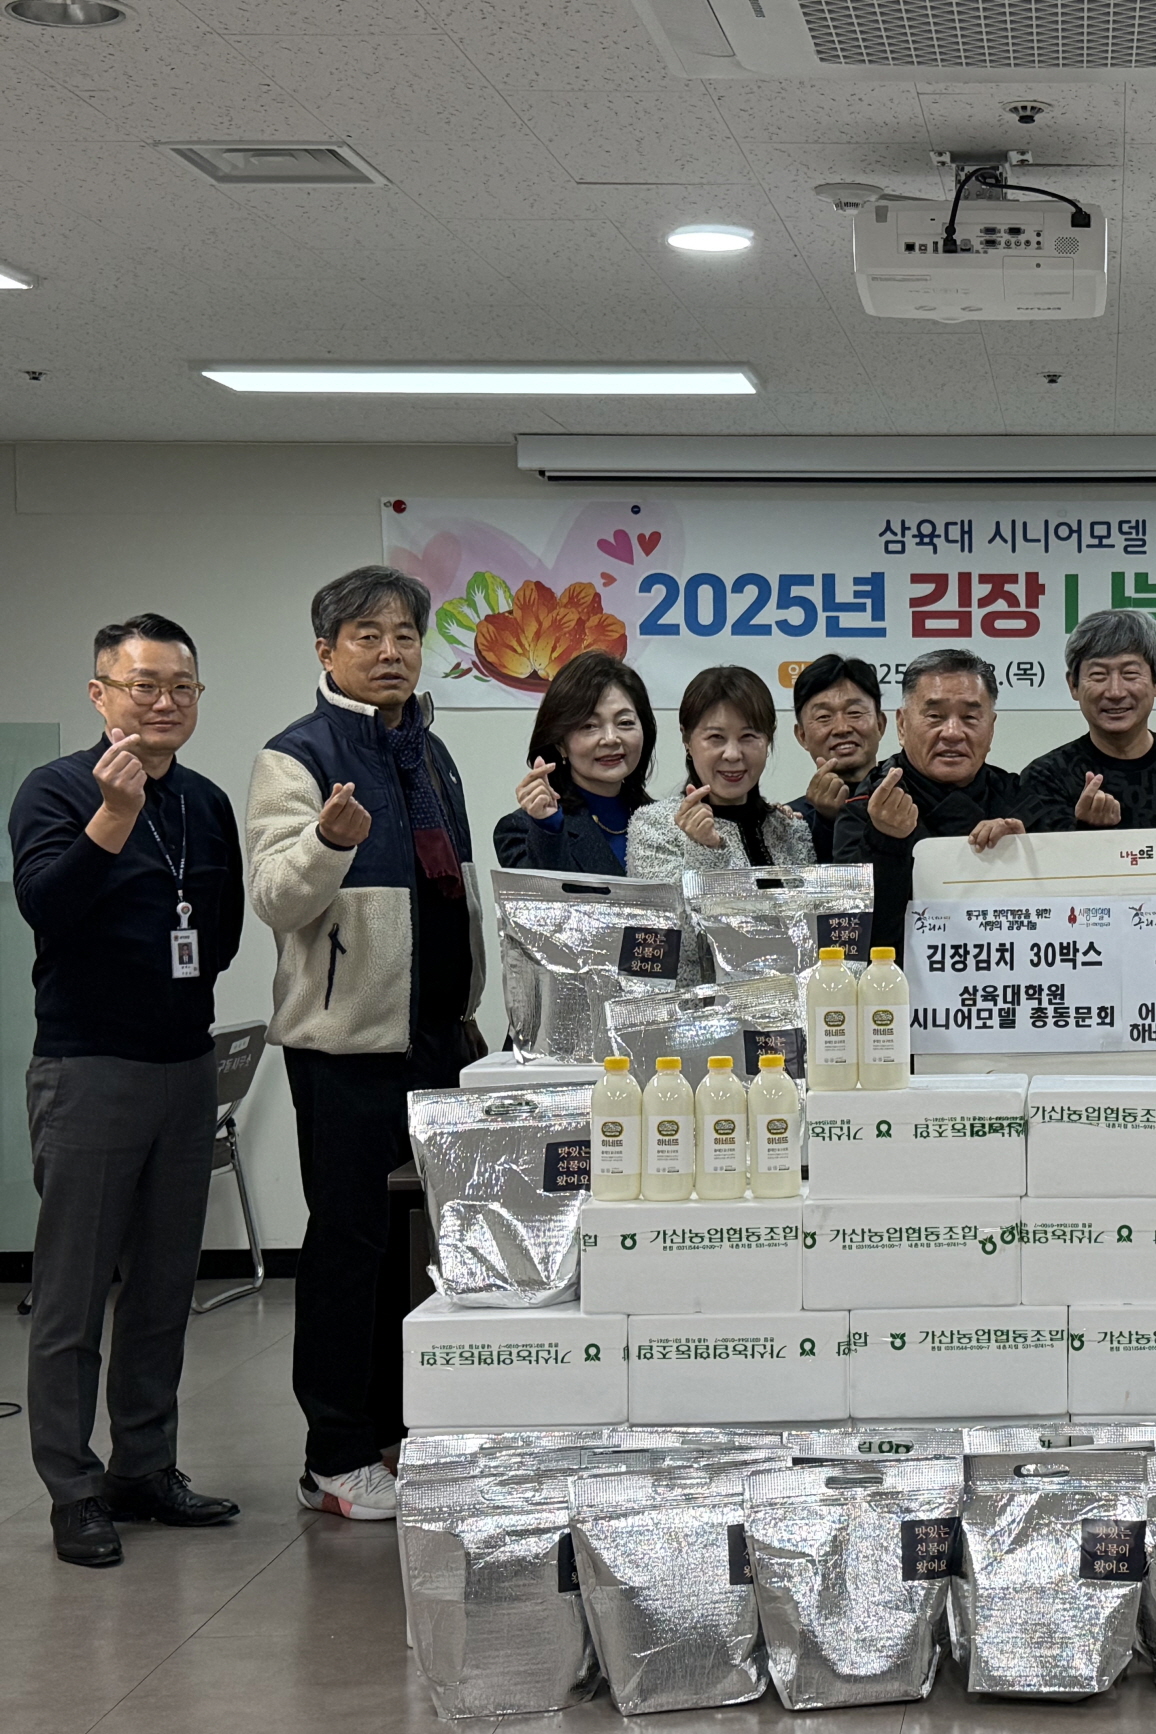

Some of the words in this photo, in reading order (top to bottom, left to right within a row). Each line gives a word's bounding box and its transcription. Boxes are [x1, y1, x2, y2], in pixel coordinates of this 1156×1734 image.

[878, 519, 973, 555] 삼육대
[987, 518, 1148, 555] 시니어모델
[637, 571, 887, 638] 2025년
[908, 571, 1046, 638] 김장
[1119, 845, 1154, 866] 나눔으로
[829, 917, 860, 928] 맛있는
[635, 932, 666, 945] 맛있는
[633, 946, 664, 960] 선물이
[926, 941, 1015, 972] 김장김치
[1029, 940, 1103, 970] 30박스
[631, 960, 662, 972] 왔어요
[959, 983, 1066, 1007] 삼육대학원
[910, 1007, 1017, 1030] 시니어모델
[1029, 1005, 1115, 1029] 총동문회
[601, 1139, 623, 1147] 하네뜨
[657, 1138, 680, 1147] 하네뜨
[713, 1137, 736, 1146] 하네뜨
[766, 1136, 789, 1145] 하네뜨
[558, 1146, 590, 1157] 맛있는
[557, 1160, 590, 1171] 선물이
[556, 1174, 590, 1185] 왔어요
[650, 1225, 799, 1244] 가산농업협동조합
[829, 1225, 979, 1243] 가산농업협동조합
[420, 1350, 572, 1367] 가산농업협동조합
[636, 1344, 788, 1360] 가산농업협동조합
[915, 1525, 950, 1539] 맛있는
[1095, 1526, 1132, 1540] 맛있는
[916, 1543, 948, 1556] 선물이
[1094, 1543, 1130, 1557] 선물이
[916, 1559, 947, 1573] 왔어요
[1093, 1560, 1130, 1574] 왔어요
